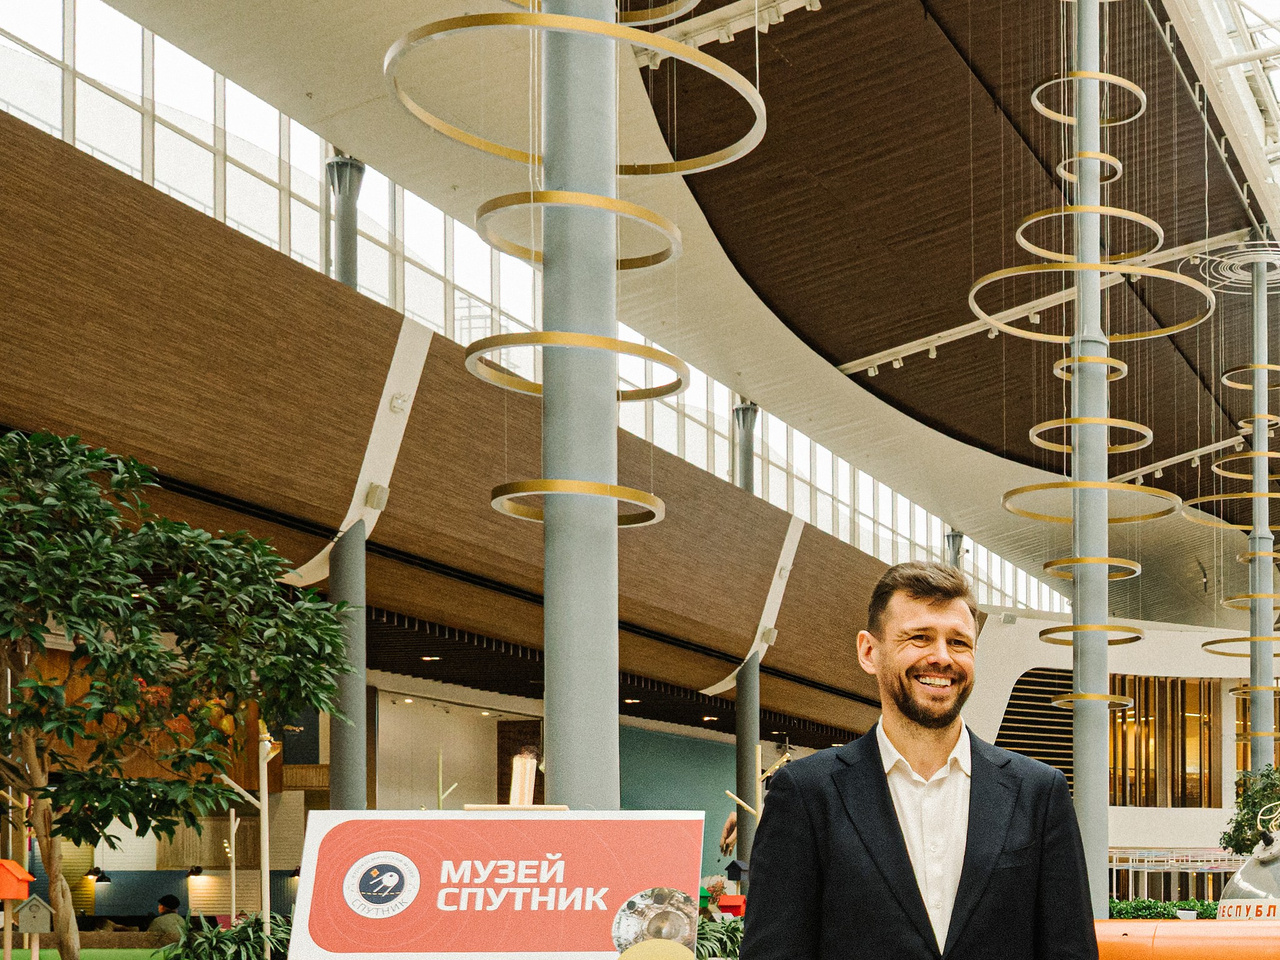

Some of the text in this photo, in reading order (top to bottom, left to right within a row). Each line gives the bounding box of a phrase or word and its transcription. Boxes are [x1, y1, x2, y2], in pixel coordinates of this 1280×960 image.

[440, 852, 565, 884] МУЗЕЙ
[351, 898, 408, 916] СПУТНИК
[436, 887, 609, 912] СПУТНИК
